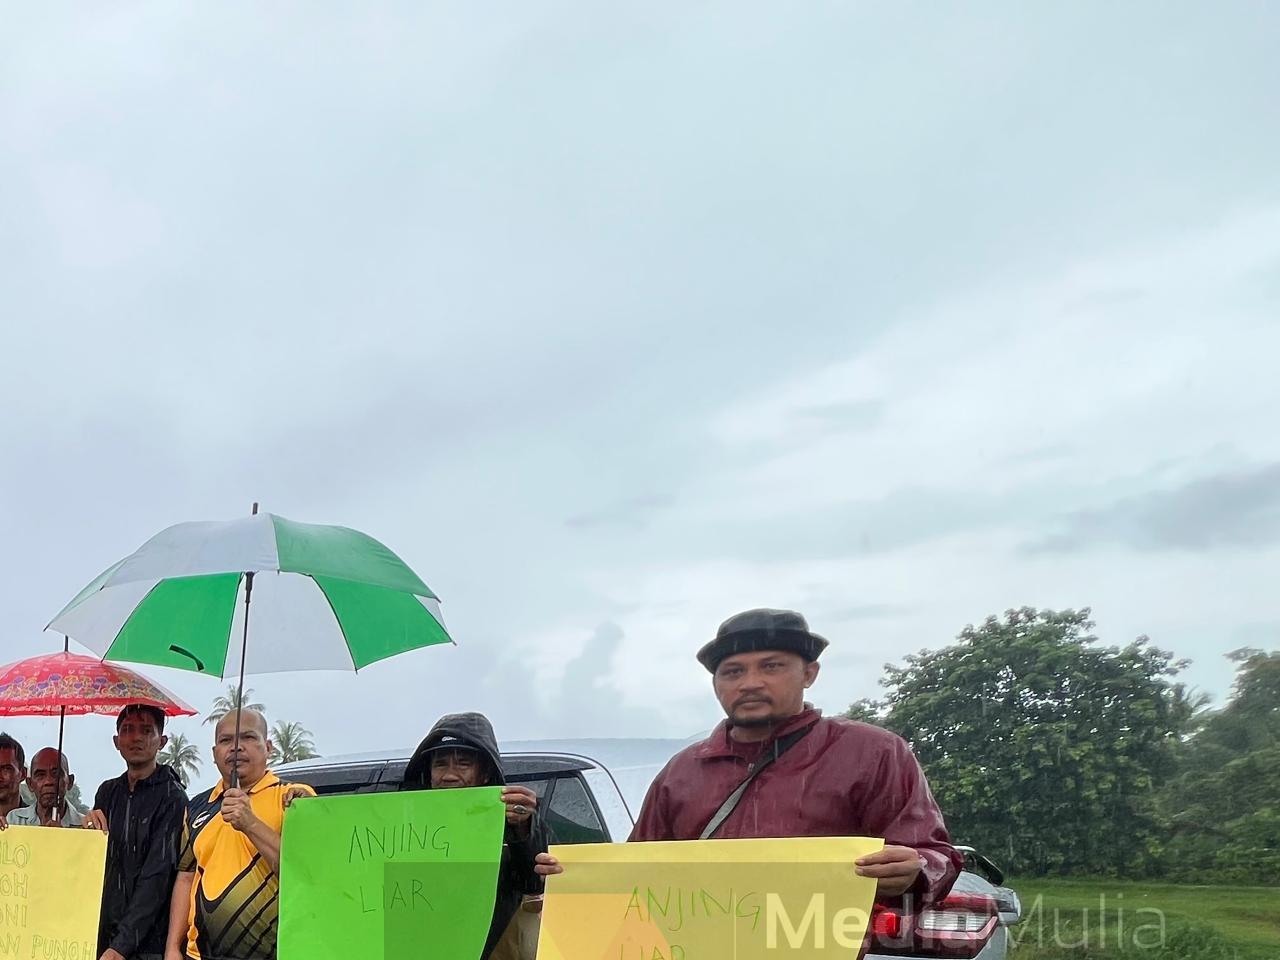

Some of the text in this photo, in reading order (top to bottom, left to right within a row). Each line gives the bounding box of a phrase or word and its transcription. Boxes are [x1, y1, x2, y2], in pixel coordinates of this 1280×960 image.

[348, 822, 450, 863] ANJING
[359, 879, 434, 913] LIAR
[624, 886, 761, 932] ANJING
